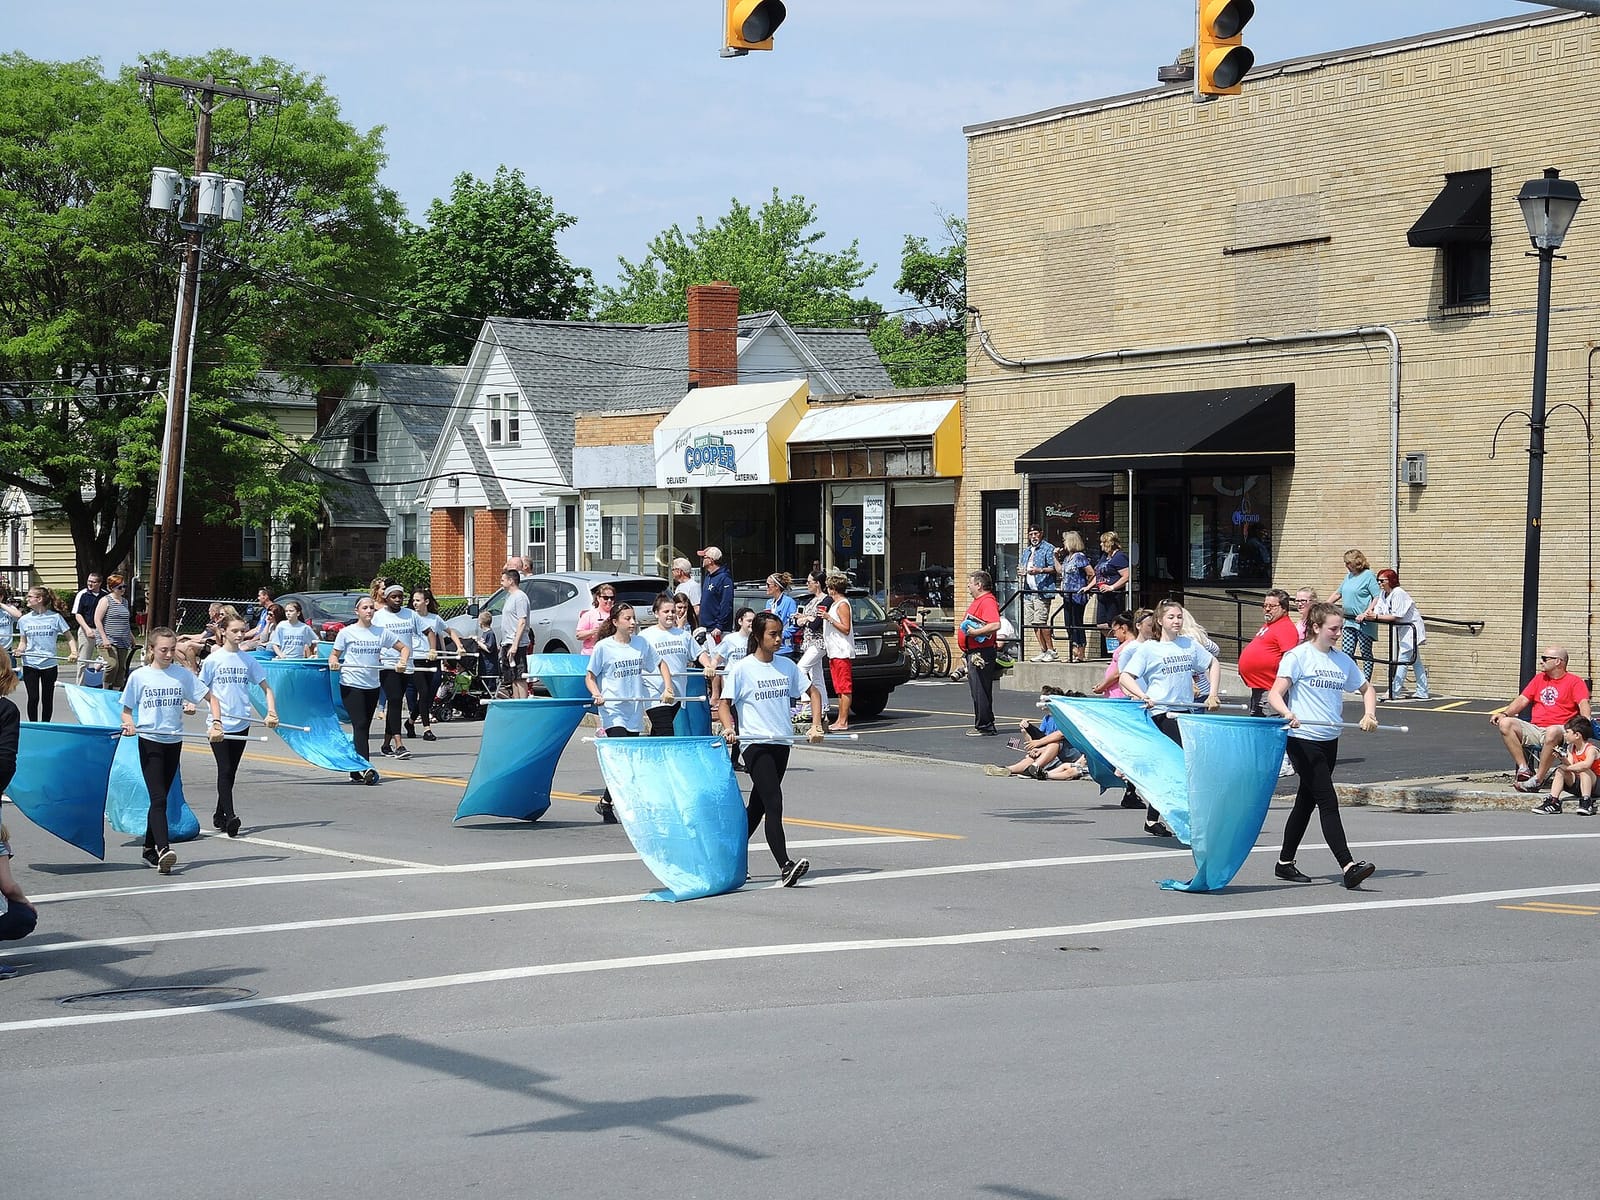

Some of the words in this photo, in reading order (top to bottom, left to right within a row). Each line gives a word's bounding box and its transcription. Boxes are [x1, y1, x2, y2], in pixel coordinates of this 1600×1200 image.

[684, 446, 737, 473] COOPER
[666, 477, 688, 485] DELIVERY
[734, 474, 758, 482] CATERING
[756, 677, 790, 689] EASTRIDGE
[144, 687, 182, 698] EASTRIDGE
